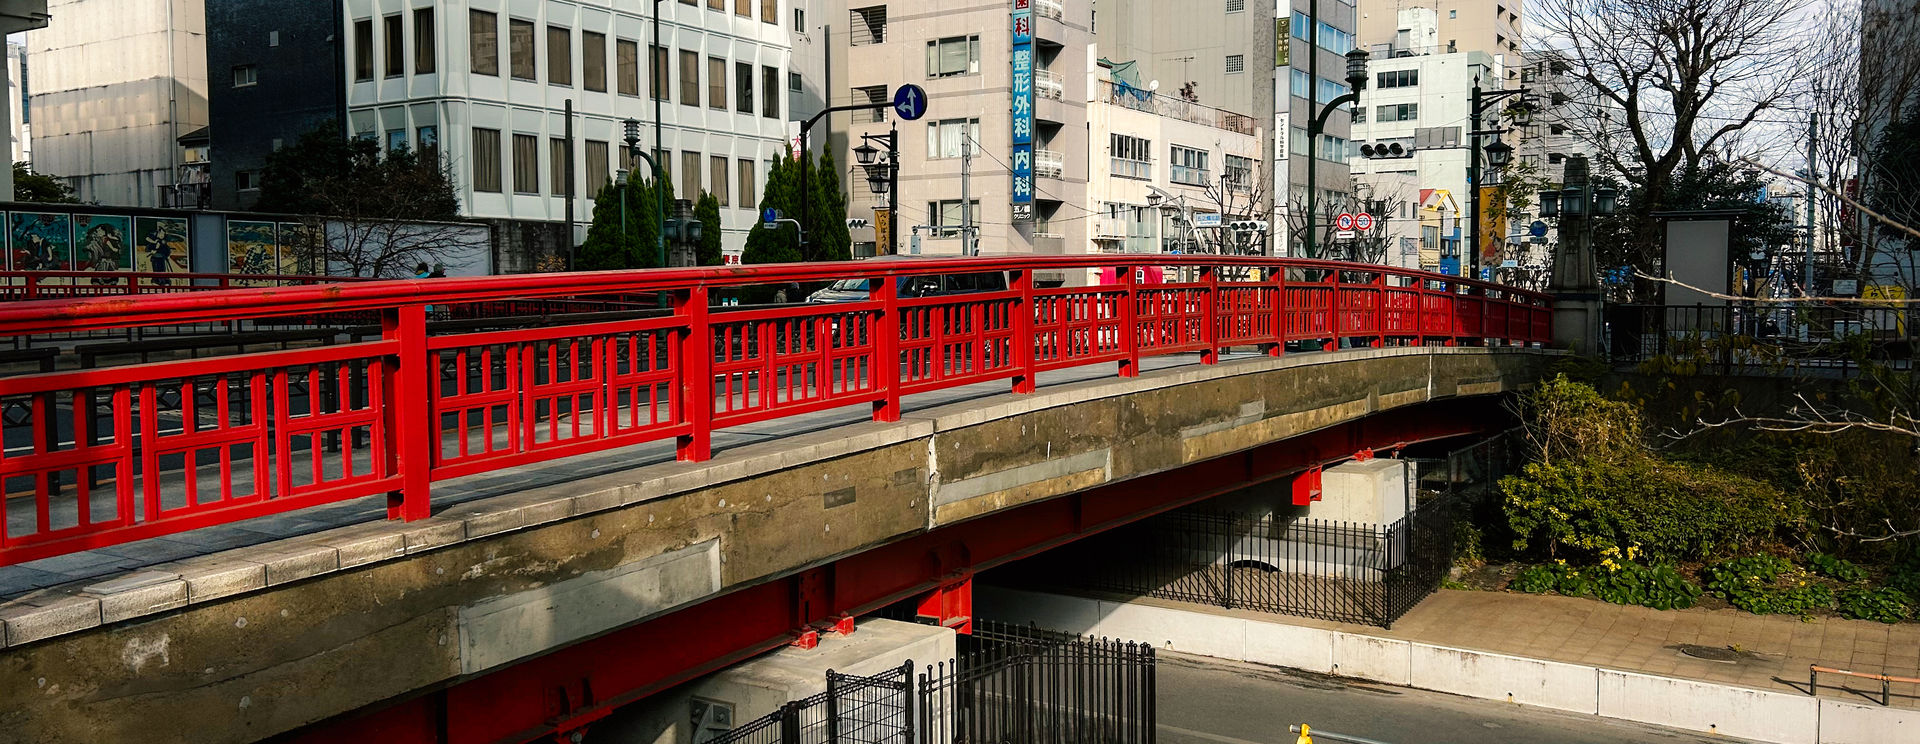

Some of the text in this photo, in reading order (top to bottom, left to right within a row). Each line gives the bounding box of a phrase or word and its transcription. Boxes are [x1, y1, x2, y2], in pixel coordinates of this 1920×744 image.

[1014, 50, 1030, 137] 整形外科
[1014, 149, 1030, 196] 内科
[1358, 217, 1368, 226] 50
